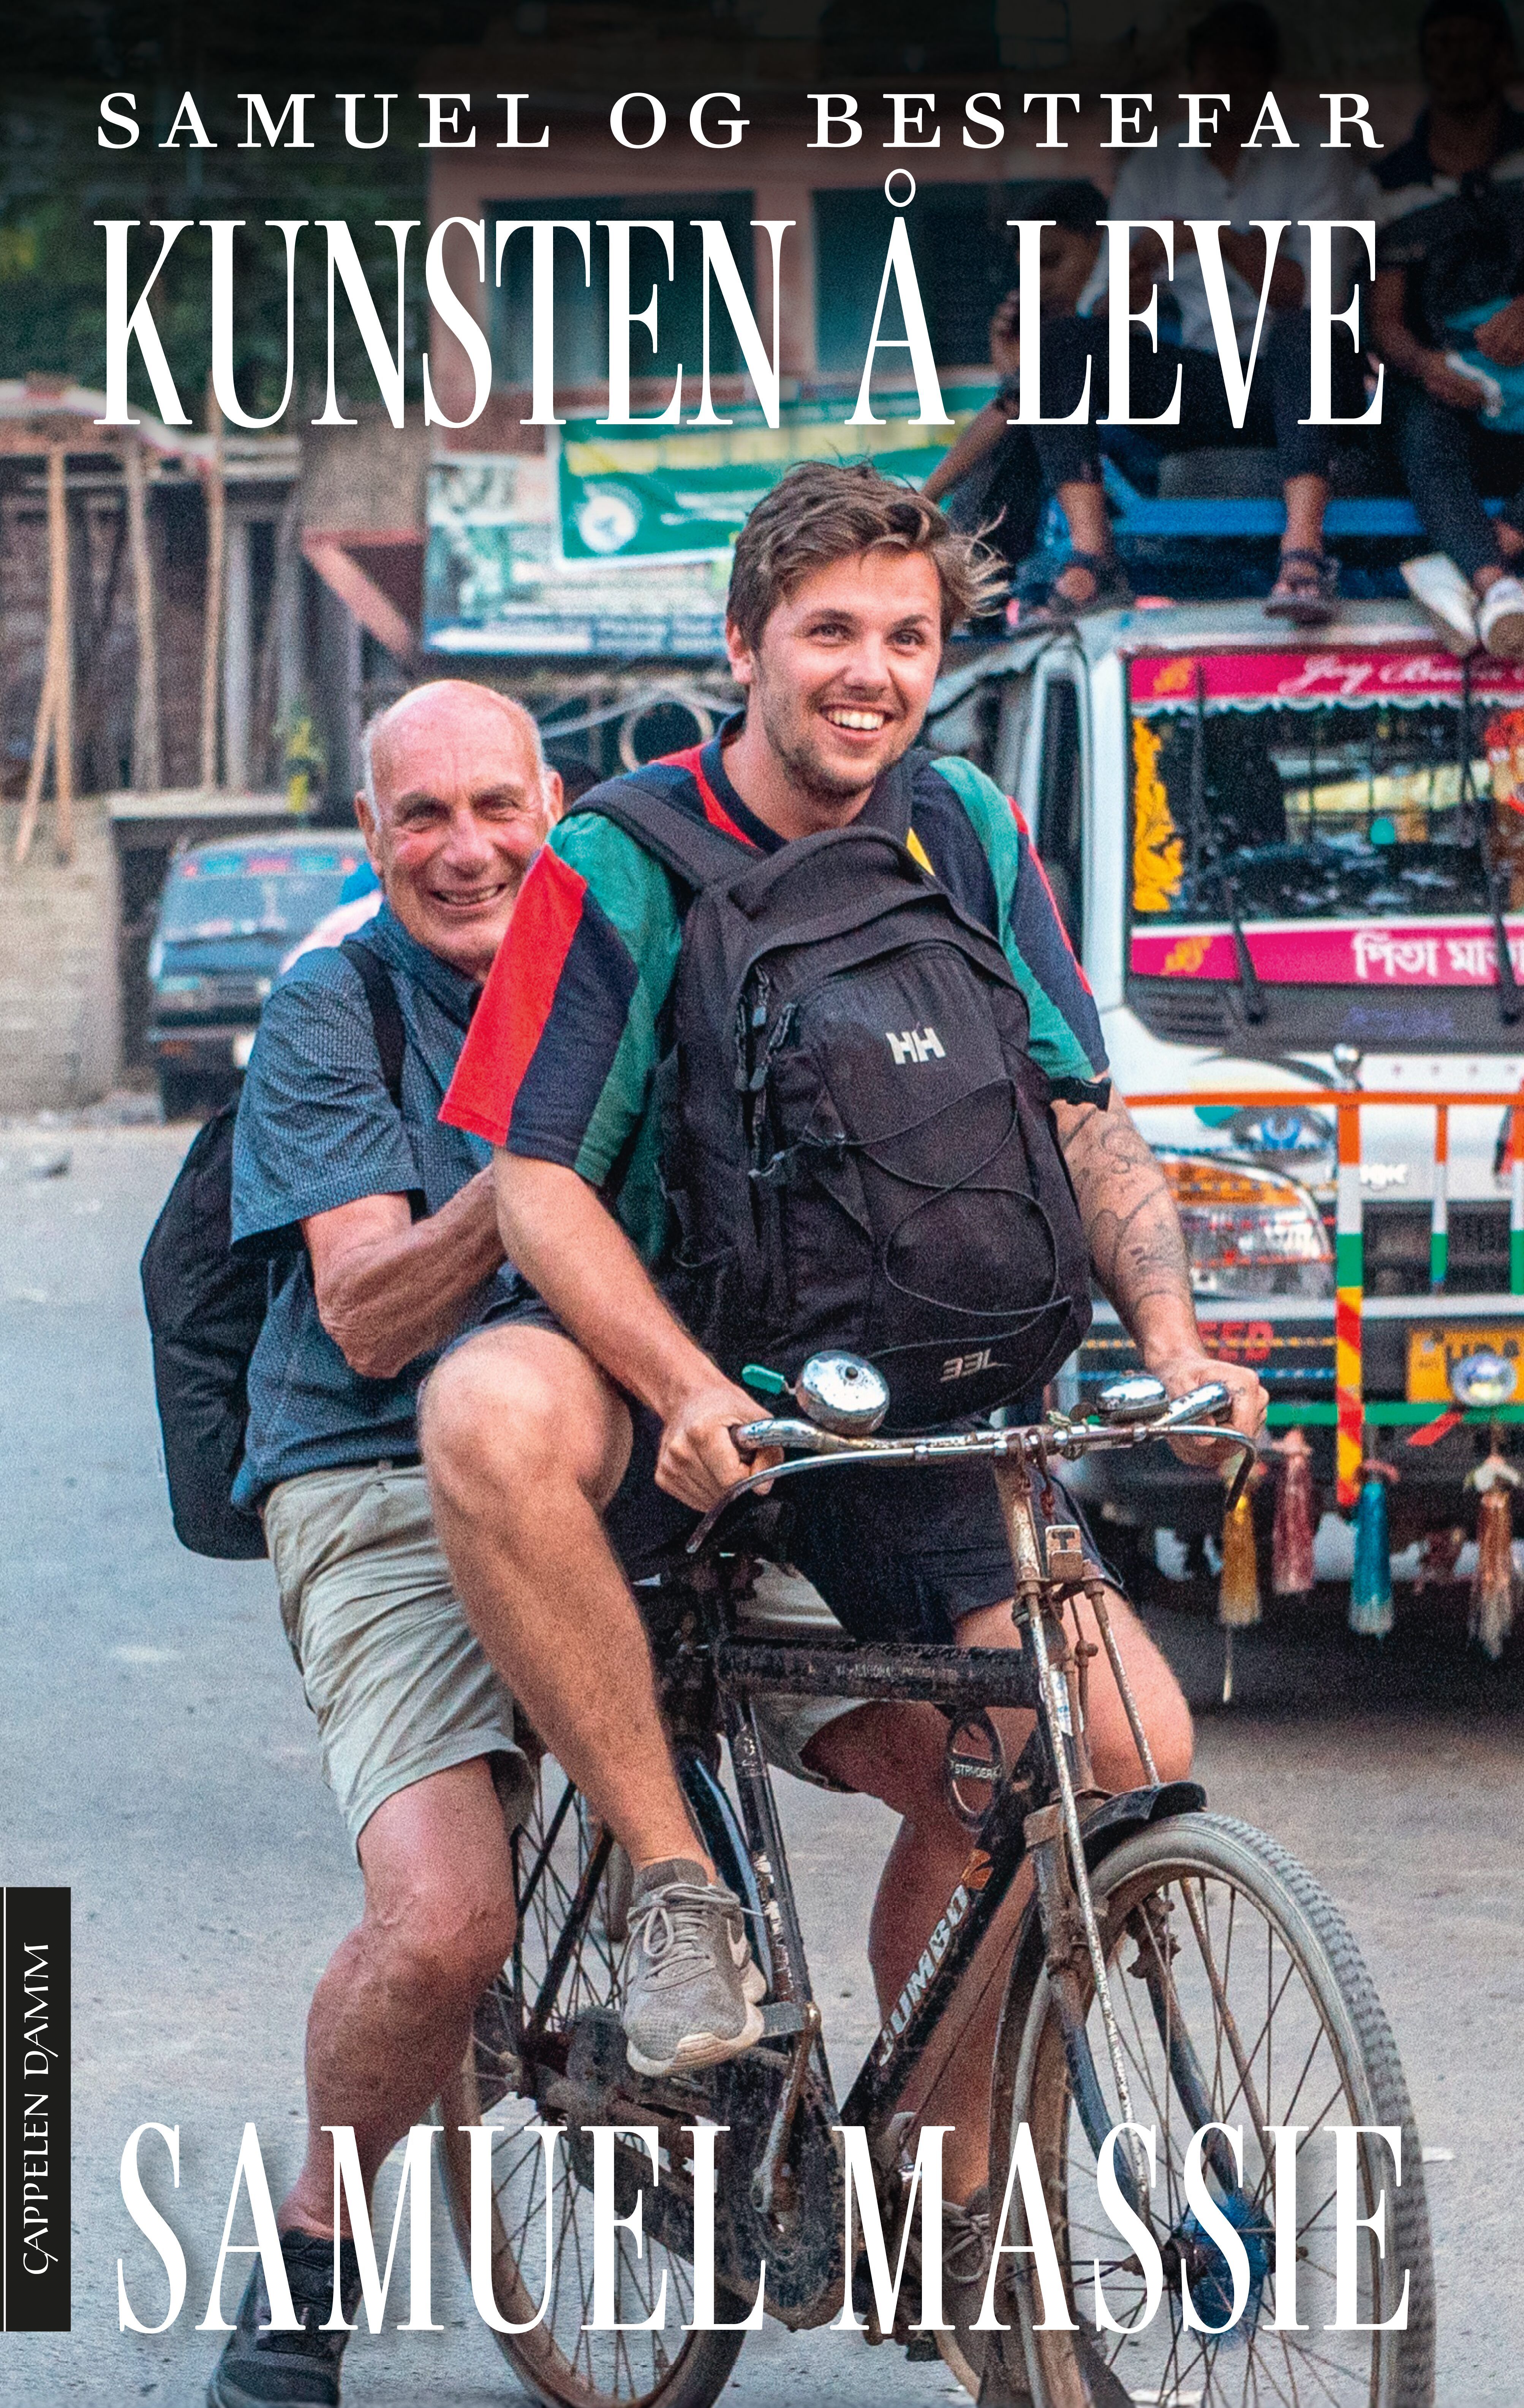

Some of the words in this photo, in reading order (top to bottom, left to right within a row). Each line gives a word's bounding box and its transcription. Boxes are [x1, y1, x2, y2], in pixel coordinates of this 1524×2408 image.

[1352, 931, 1439, 978] পিতা
[885, 1028, 946, 1064] HH
[940, 1348, 998, 1383] 33L
